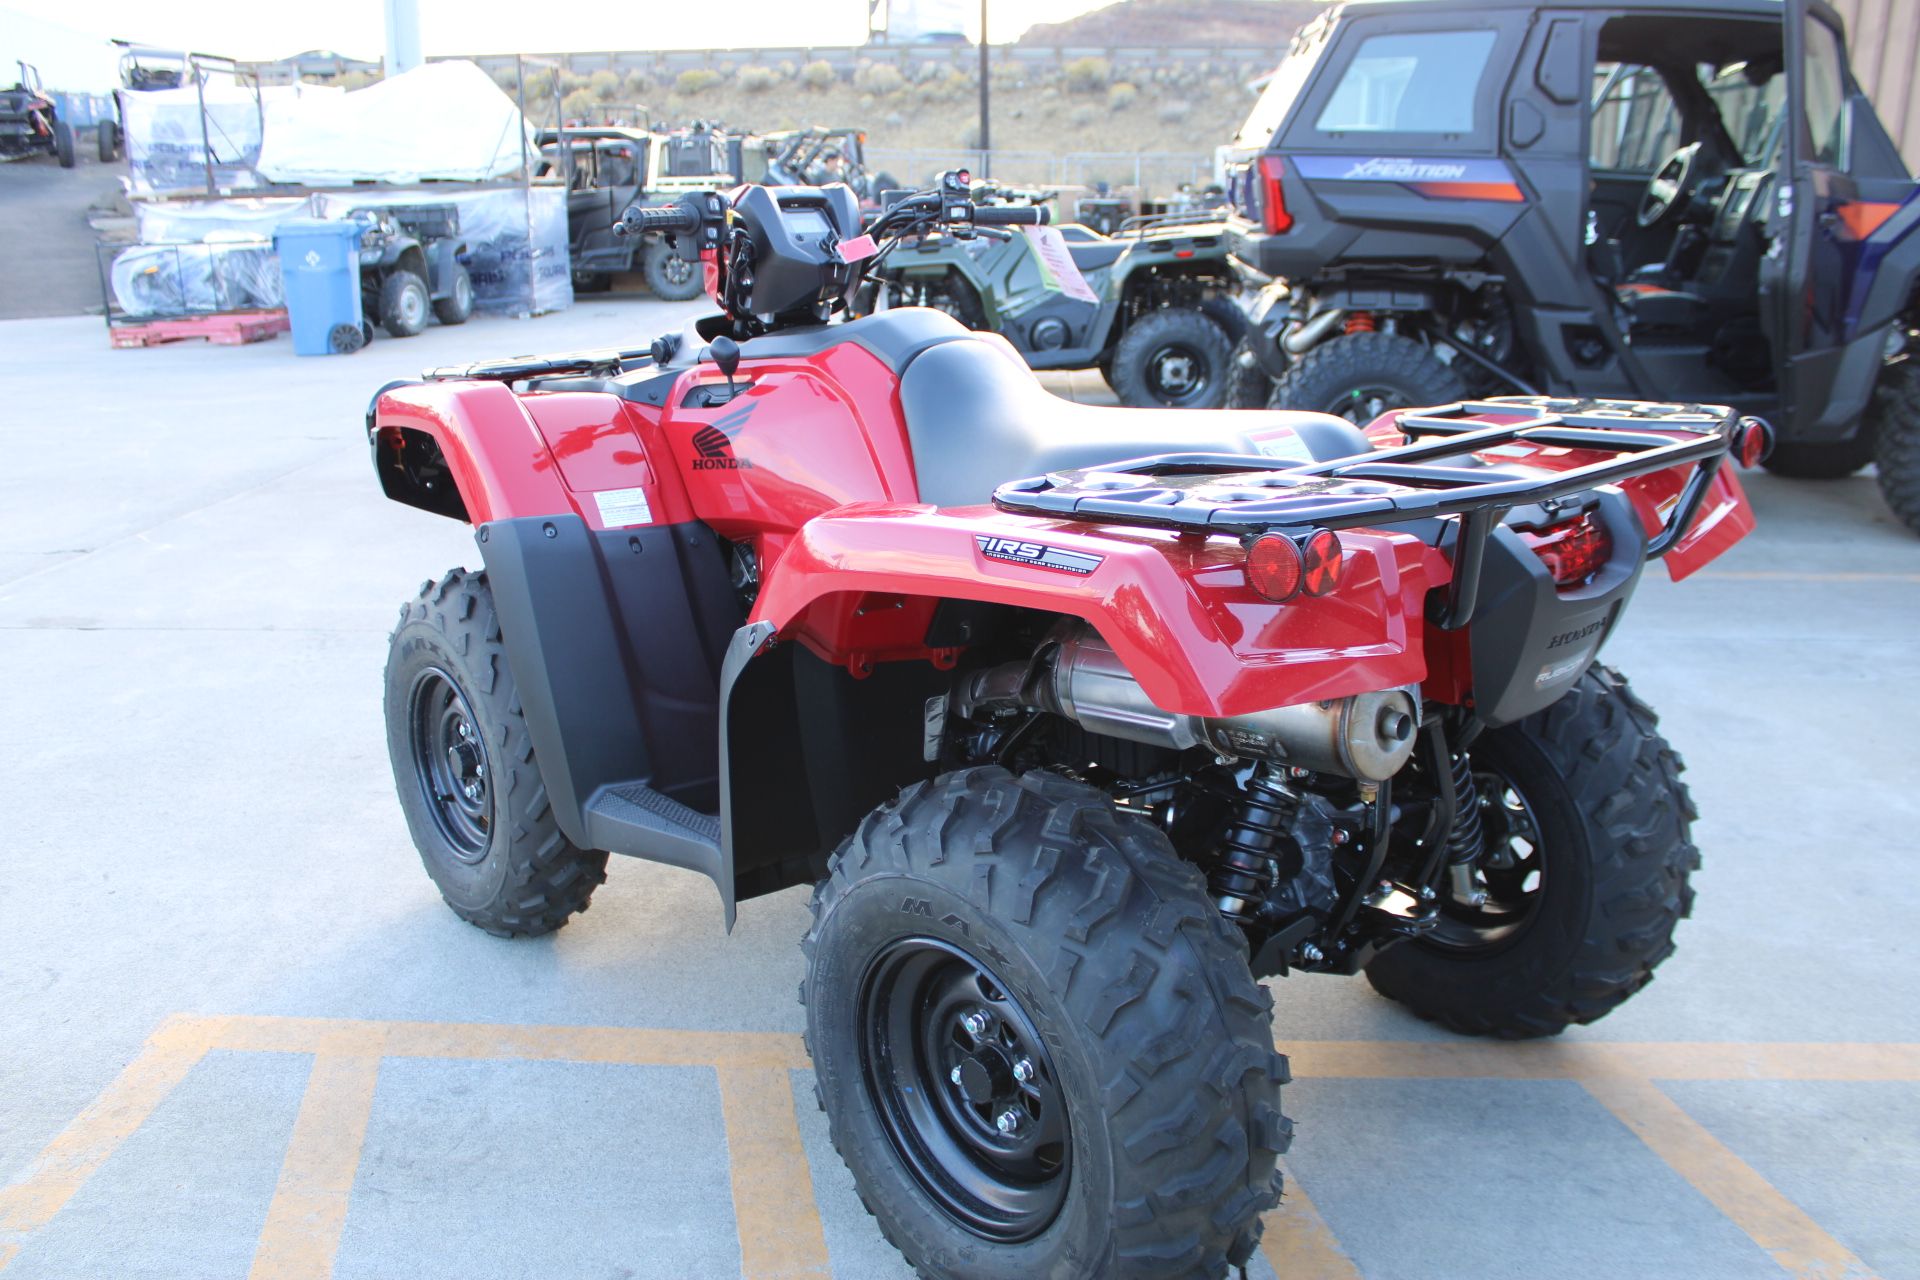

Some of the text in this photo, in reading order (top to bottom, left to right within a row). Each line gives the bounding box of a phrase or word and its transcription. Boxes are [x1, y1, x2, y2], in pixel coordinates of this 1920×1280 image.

[149, 143, 209, 153] POLARI
[1344, 158, 1466, 179] XPEDITION
[692, 458, 753, 470] HONDA
[986, 538, 1043, 558] IRS
